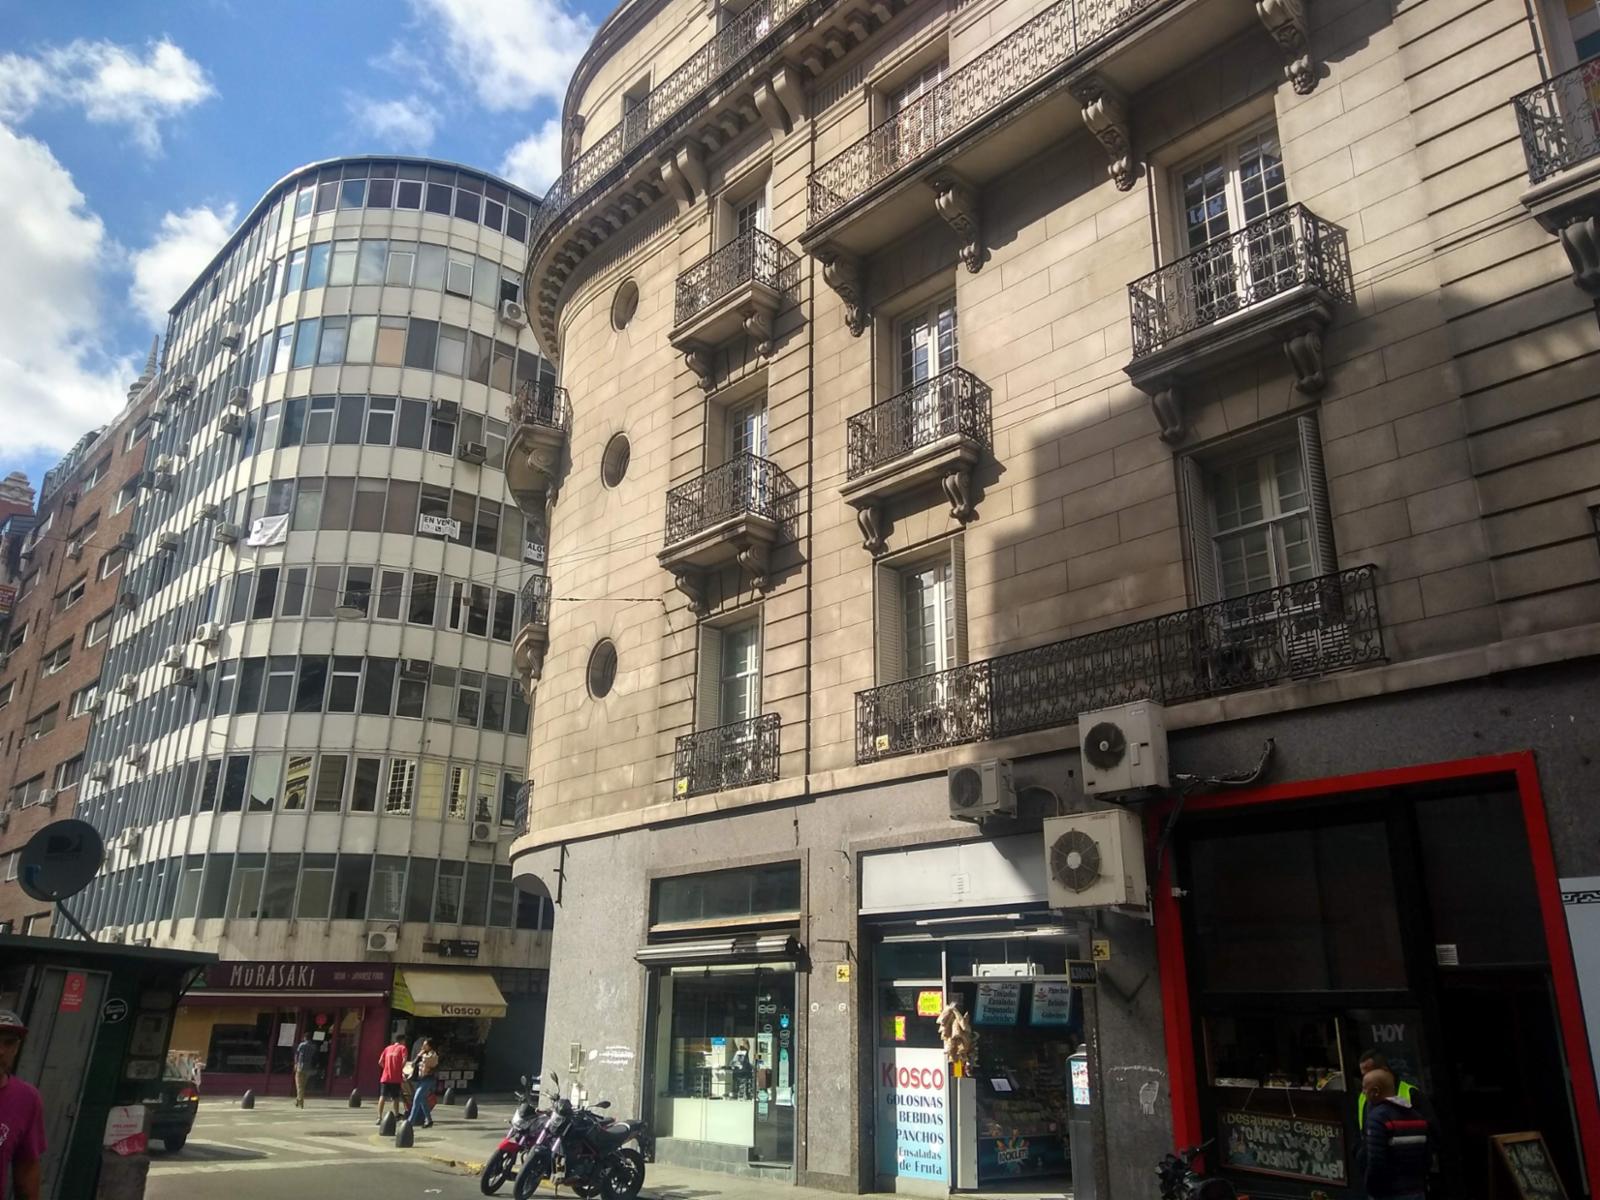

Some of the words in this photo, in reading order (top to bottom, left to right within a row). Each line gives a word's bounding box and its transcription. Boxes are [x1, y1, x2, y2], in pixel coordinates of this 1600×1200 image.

[424, 516, 435, 524] EN
[437, 518, 456, 529] VENTA
[441, 1004, 481, 1015] Kiosco
[1371, 1024, 1405, 1043] HOY
[881, 1062, 945, 1090] KIOSCO
[886, 1092, 943, 1109] GOLOSINAS
[899, 1111, 944, 1126] BEBIDAS
[896, 1128, 945, 1145] PANCHOS
[898, 1147, 942, 1161] Ensaladas
[899, 1160, 911, 1171] de
[915, 1160, 942, 1176] Fruta
